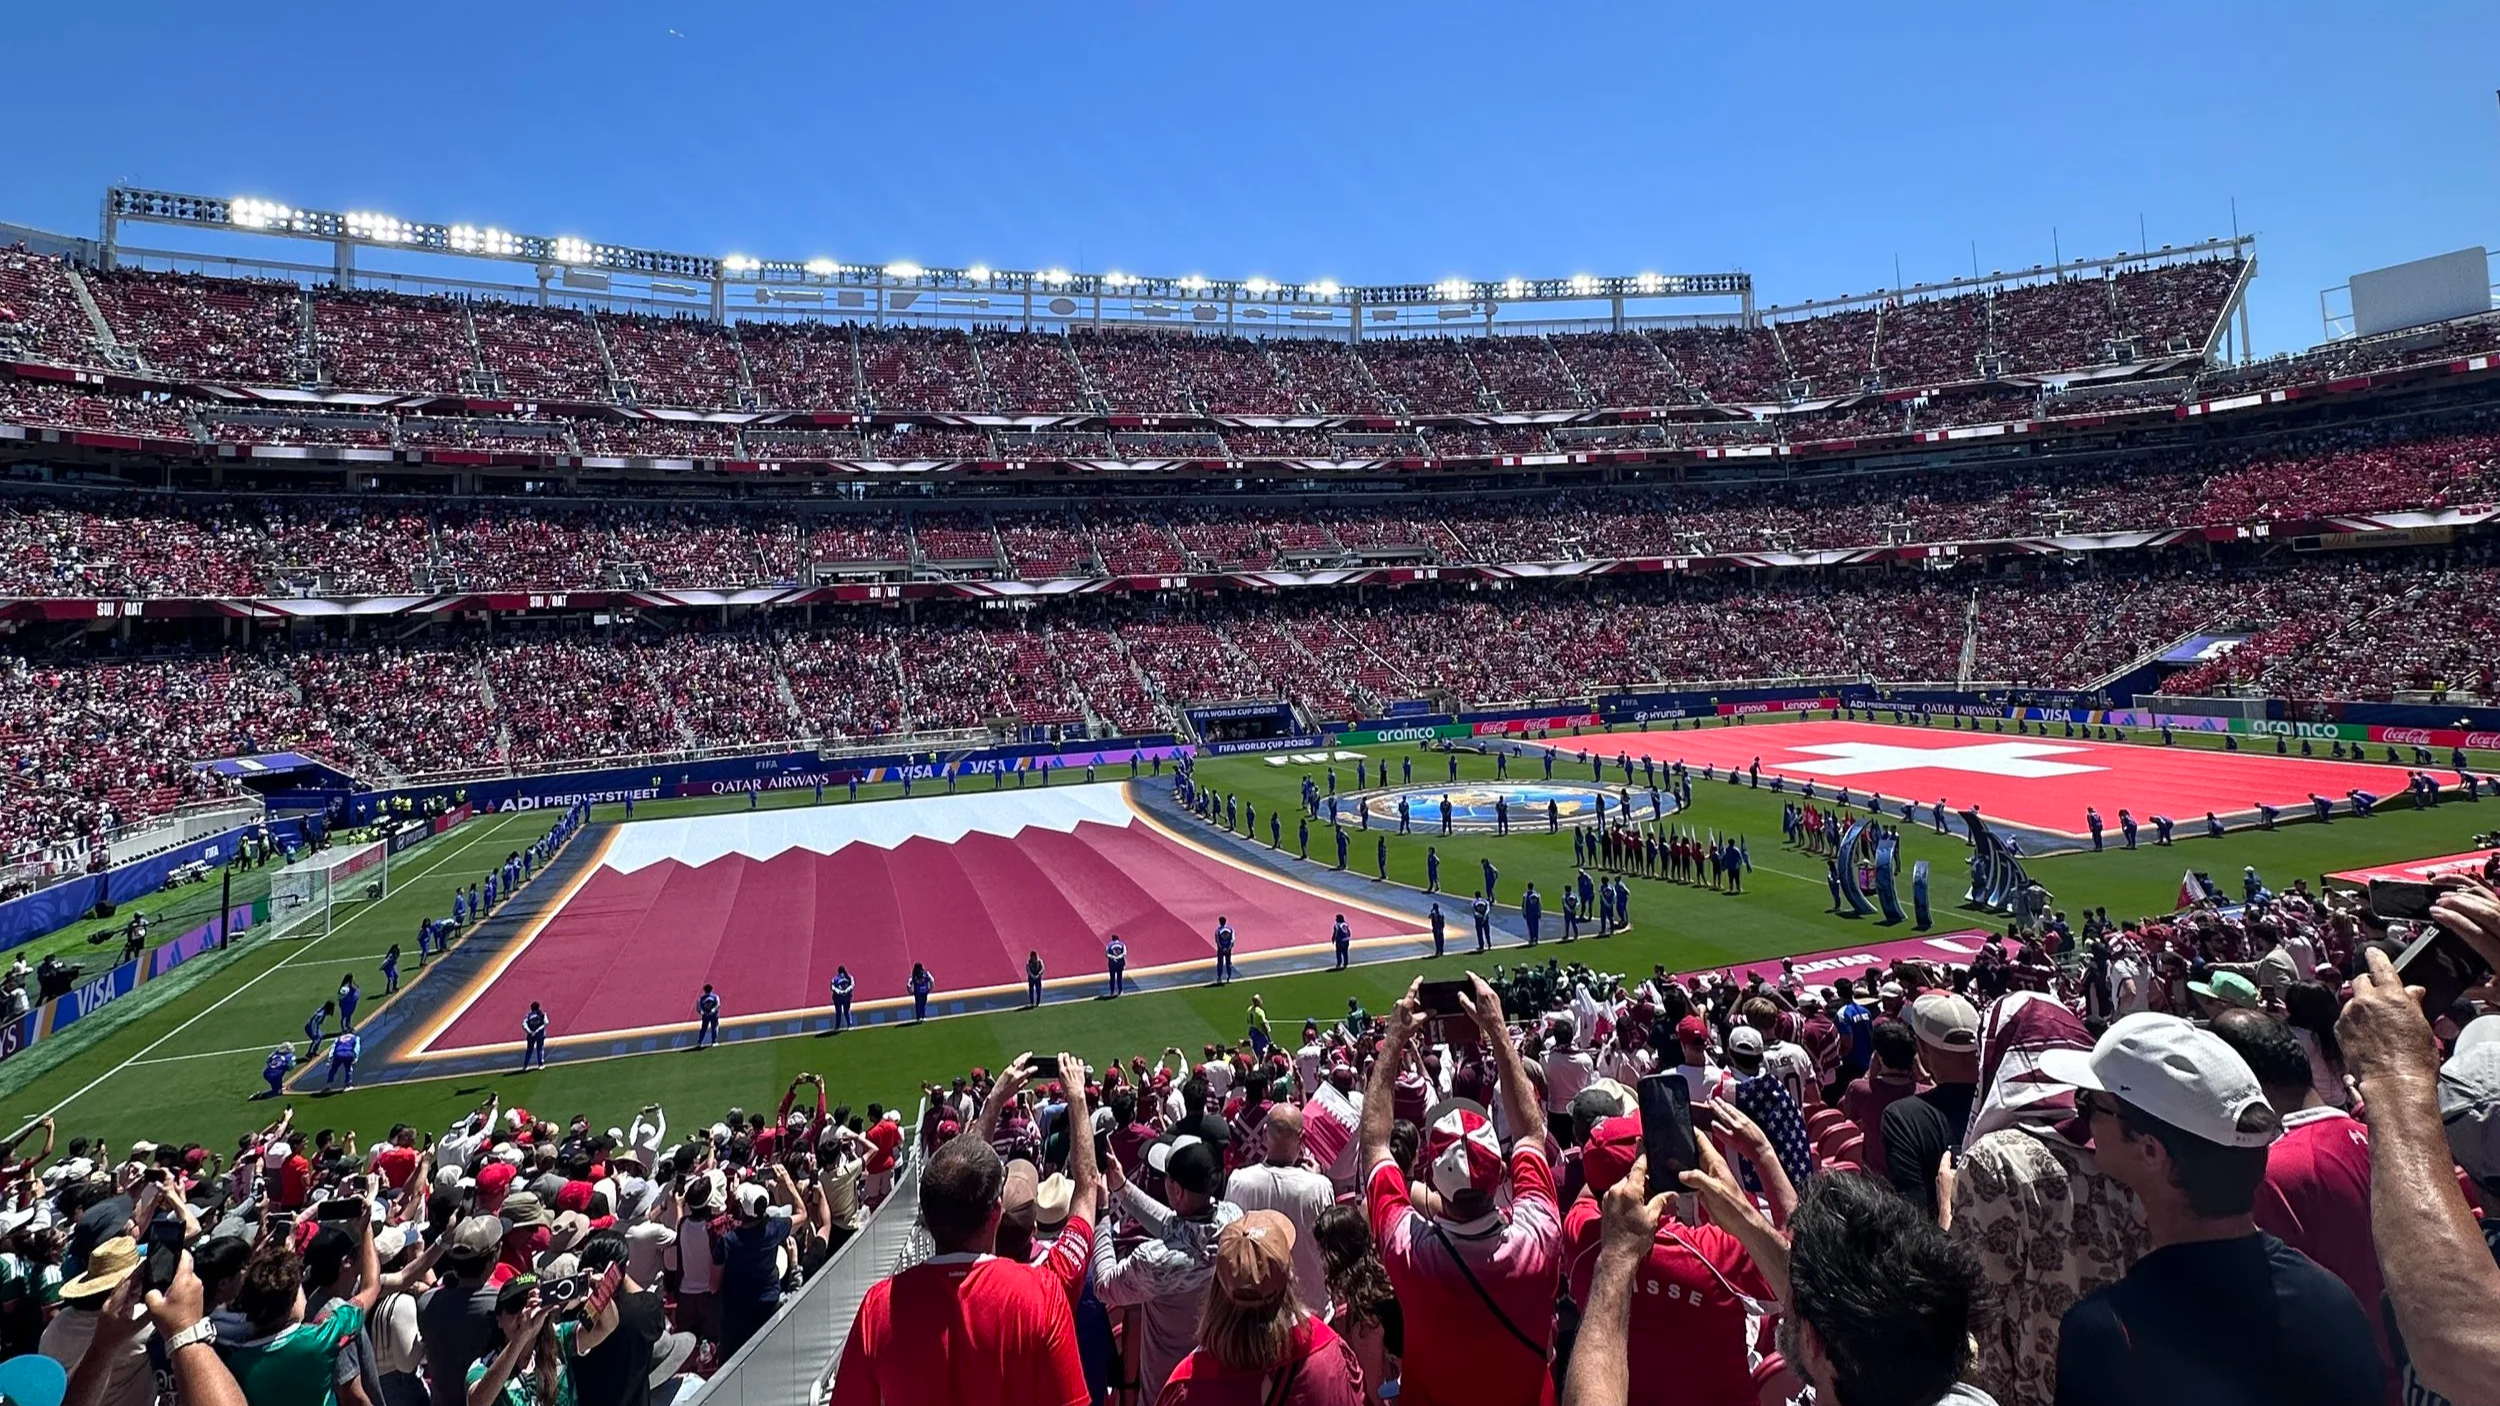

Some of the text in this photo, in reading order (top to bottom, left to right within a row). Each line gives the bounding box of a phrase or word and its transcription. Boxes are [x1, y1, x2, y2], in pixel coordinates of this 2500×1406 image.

[1210, 709, 1237, 717] WORLD
[1237, 708, 1252, 716] CUP
[1253, 706, 1278, 715] 2026
[1733, 705, 1768, 714] Lenovo
[1782, 702, 1820, 711] Lenovo
[1922, 703, 2003, 717] QATAR AIRWAYS
[1649, 709, 1686, 720] HYUNDAI
[2038, 708, 2072, 722] VISA
[1377, 727, 1435, 742] aramco
[2253, 720, 2339, 738] aramco
[1219, 738, 1312, 753] FIFA WORLD CUP 2026
[756, 760, 778, 770] FIFA
[895, 764, 934, 780] VISA
[969, 759, 1006, 774] VISA
[712, 773, 829, 795] QATAR AIRWAYS
[500, 796, 540, 812] ADI
[205, 845, 219, 860] FIFA
[1791, 953, 1883, 974] QATAR
[74, 971, 116, 1018] VISA
